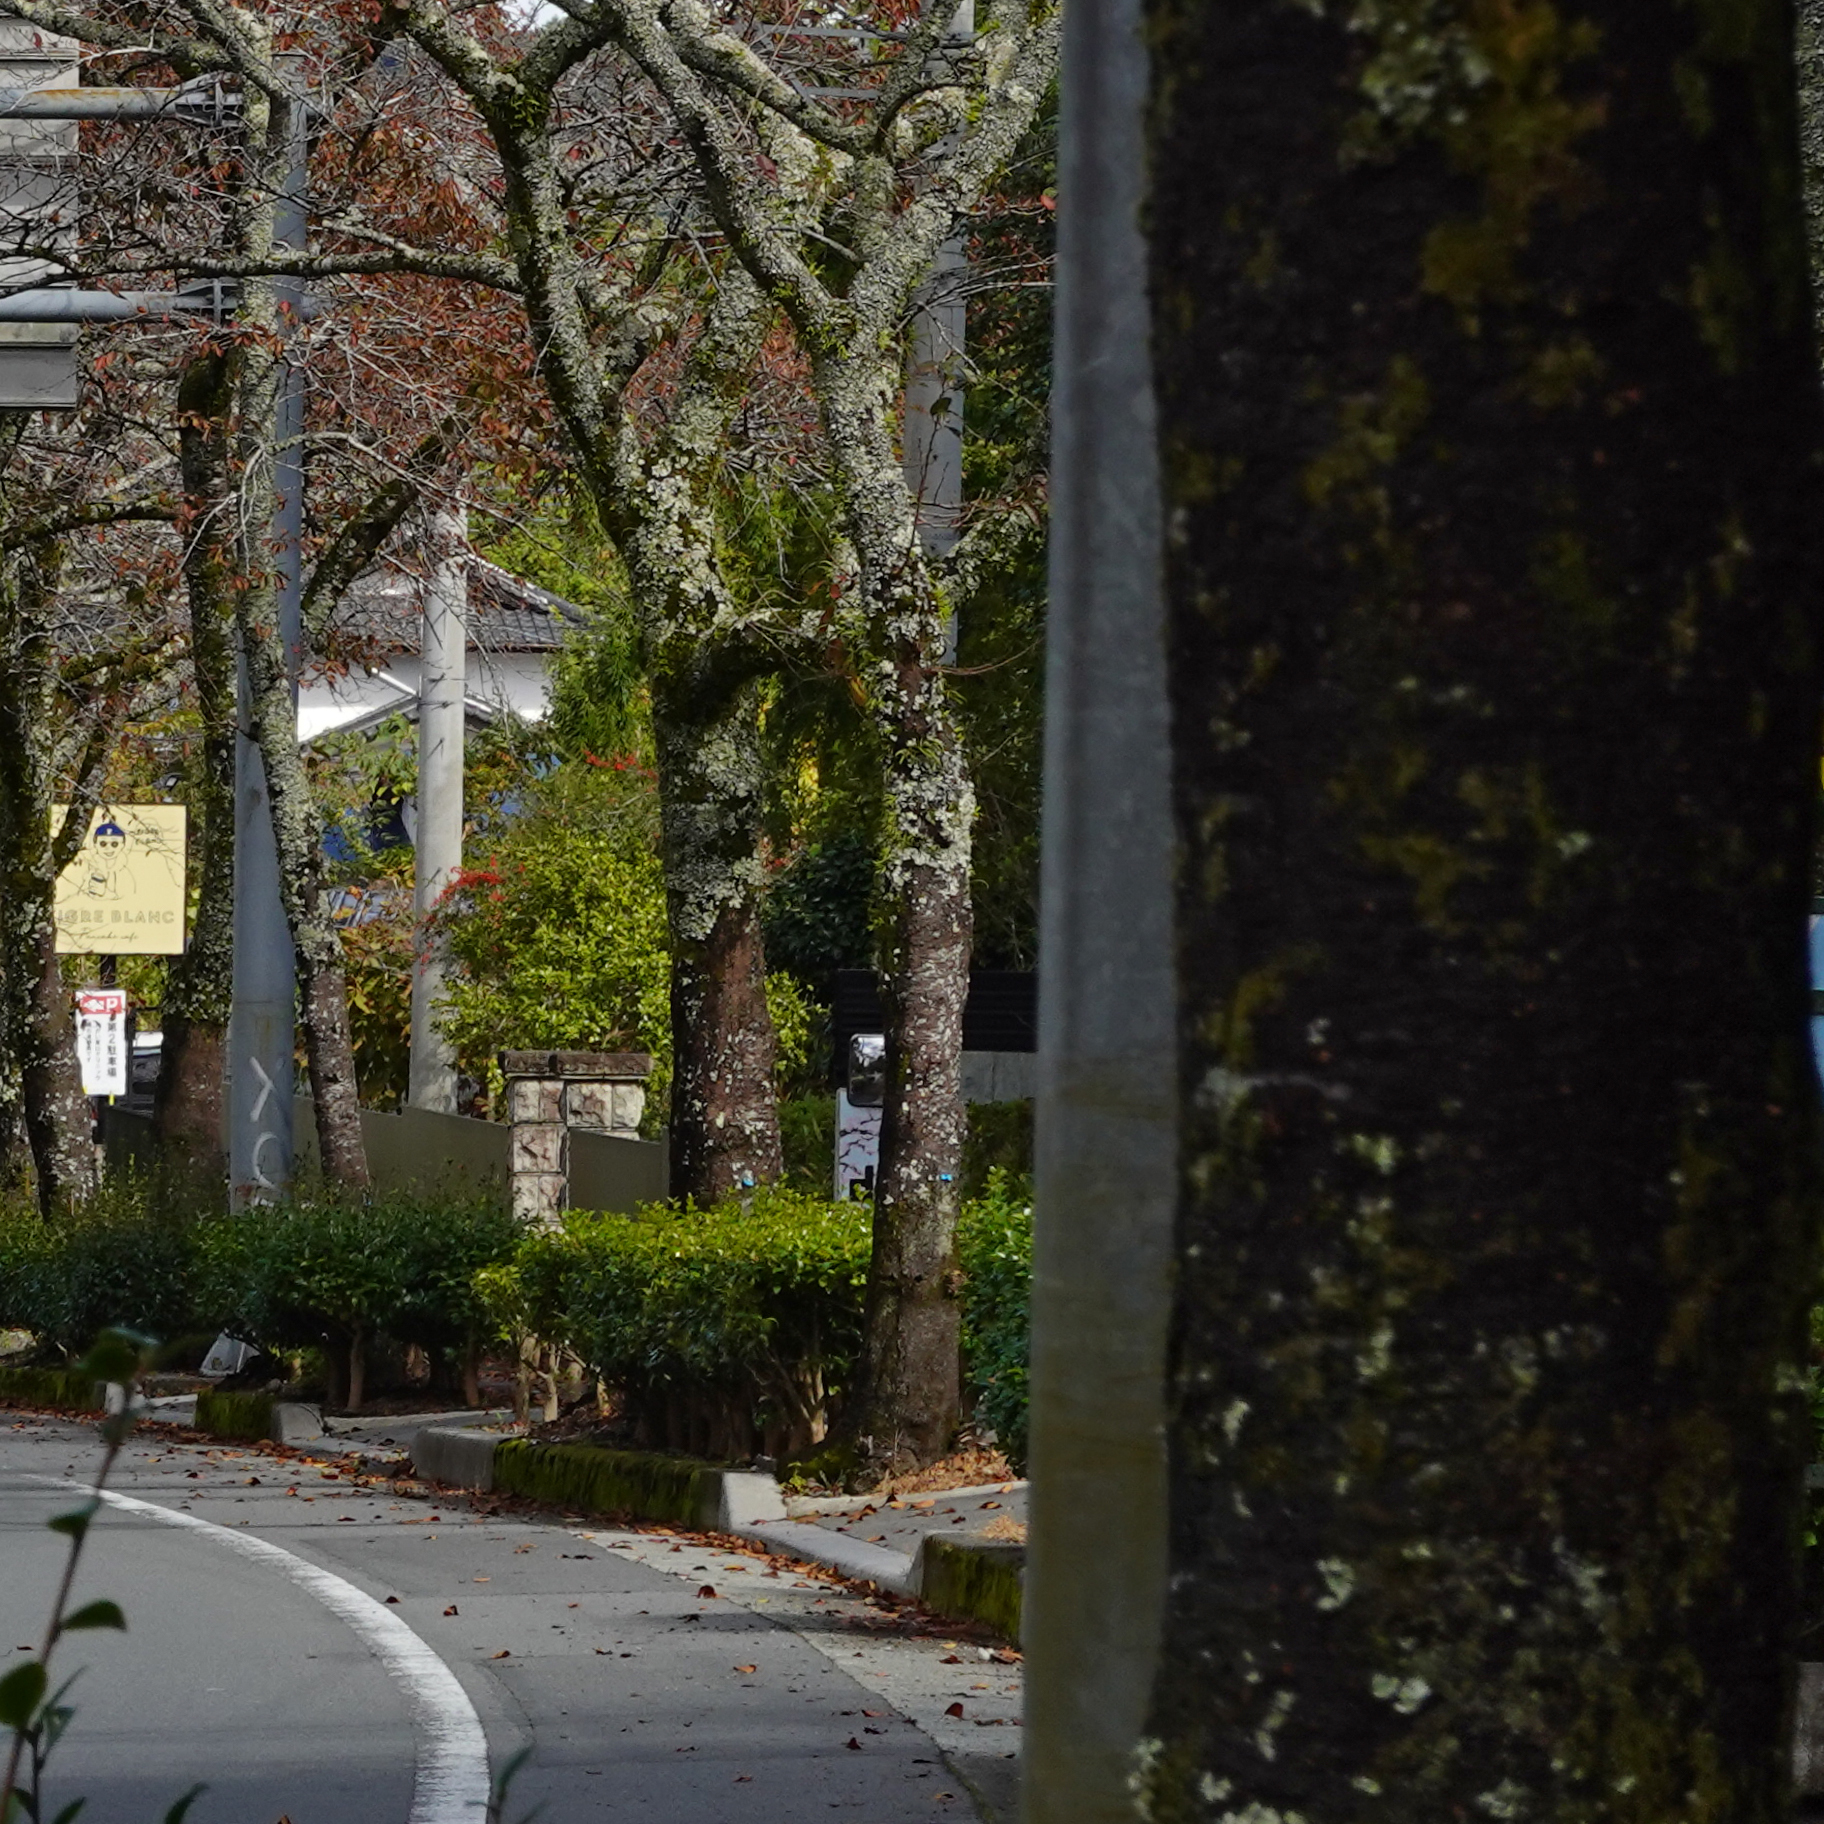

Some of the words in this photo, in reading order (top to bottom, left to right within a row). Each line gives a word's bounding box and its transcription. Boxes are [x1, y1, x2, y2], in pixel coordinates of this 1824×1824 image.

[55, 909, 104, 923] IGRE
[110, 910, 175, 924] BLANC
[106, 998, 118, 1012] P
